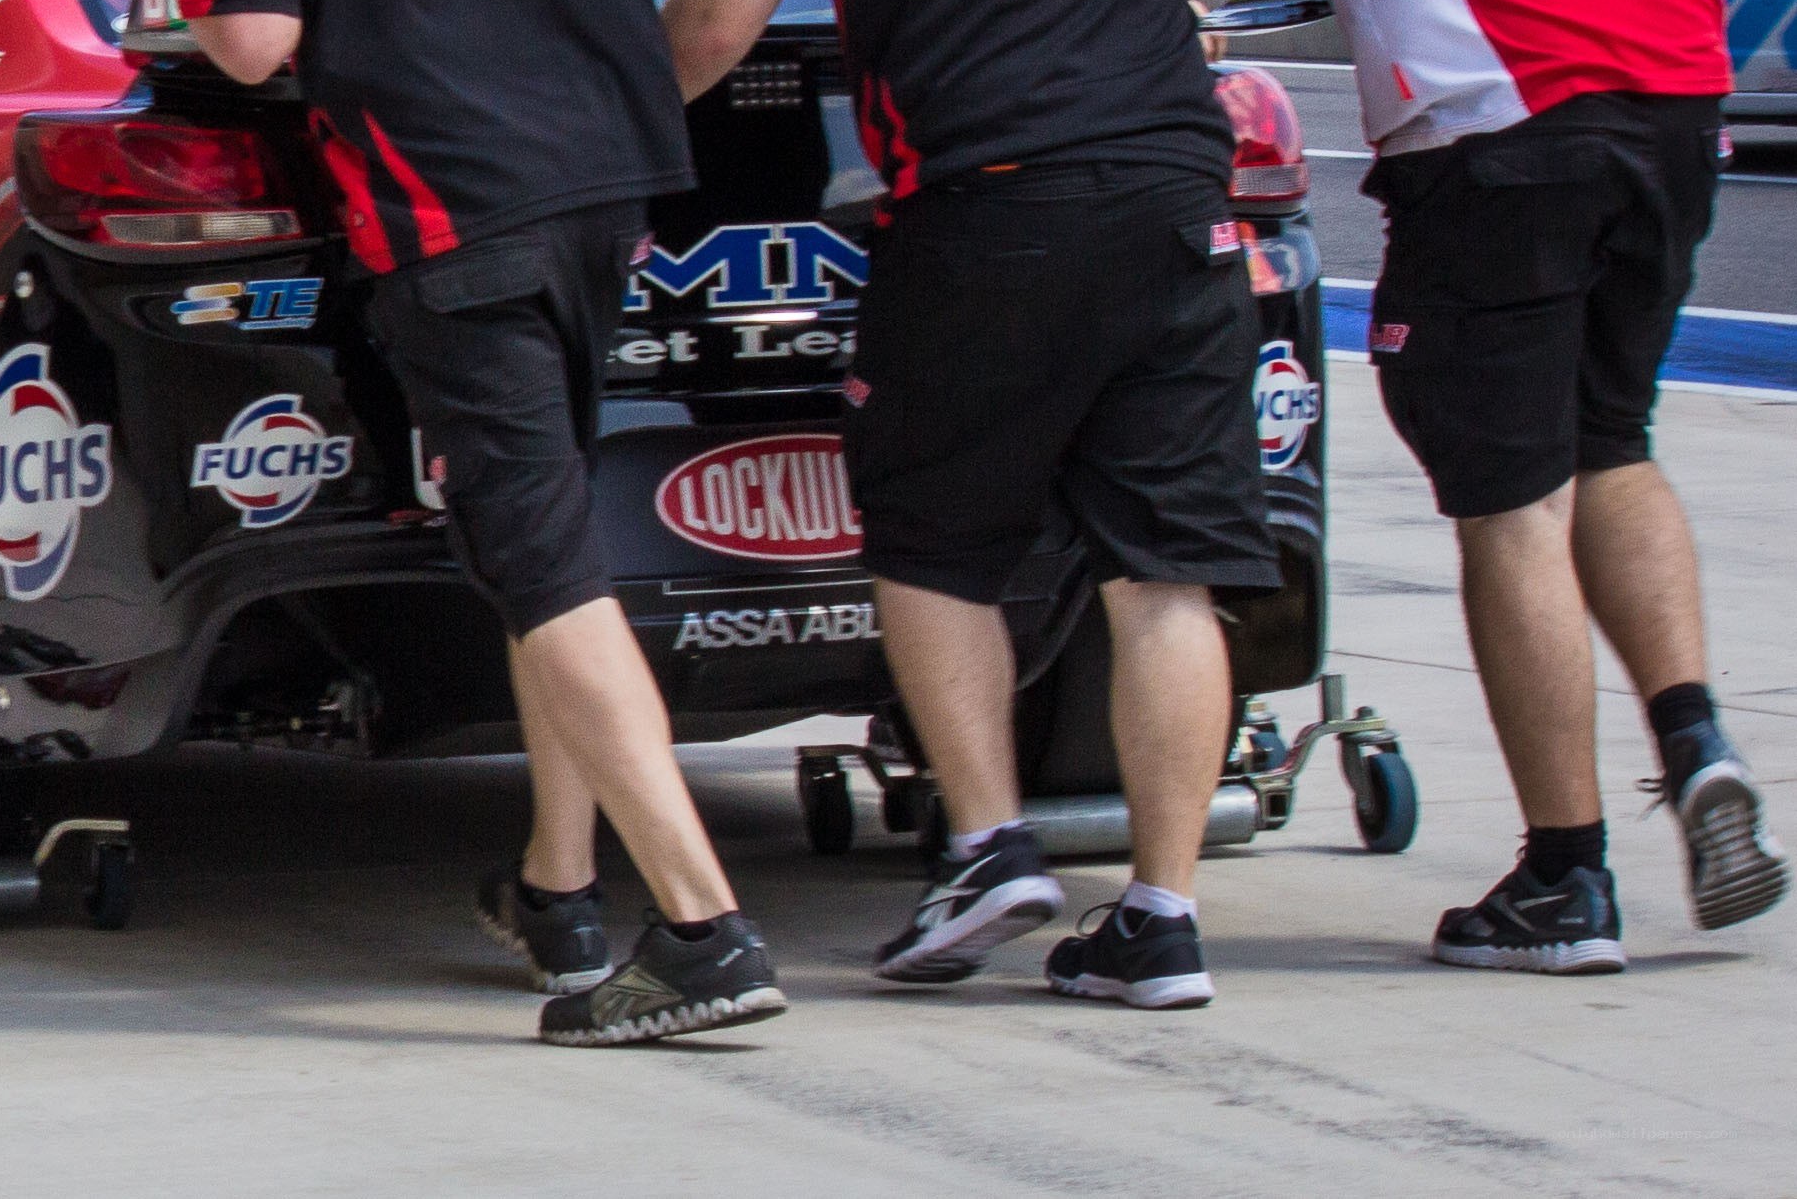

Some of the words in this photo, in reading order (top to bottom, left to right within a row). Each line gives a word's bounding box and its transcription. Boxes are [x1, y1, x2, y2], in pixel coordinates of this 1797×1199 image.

[245, 277, 324, 318] TE
[606, 329, 699, 364] et
[198, 440, 349, 482] FUCHS
[674, 610, 795, 650] ASSA
[801, 604, 883, 645] ABL
